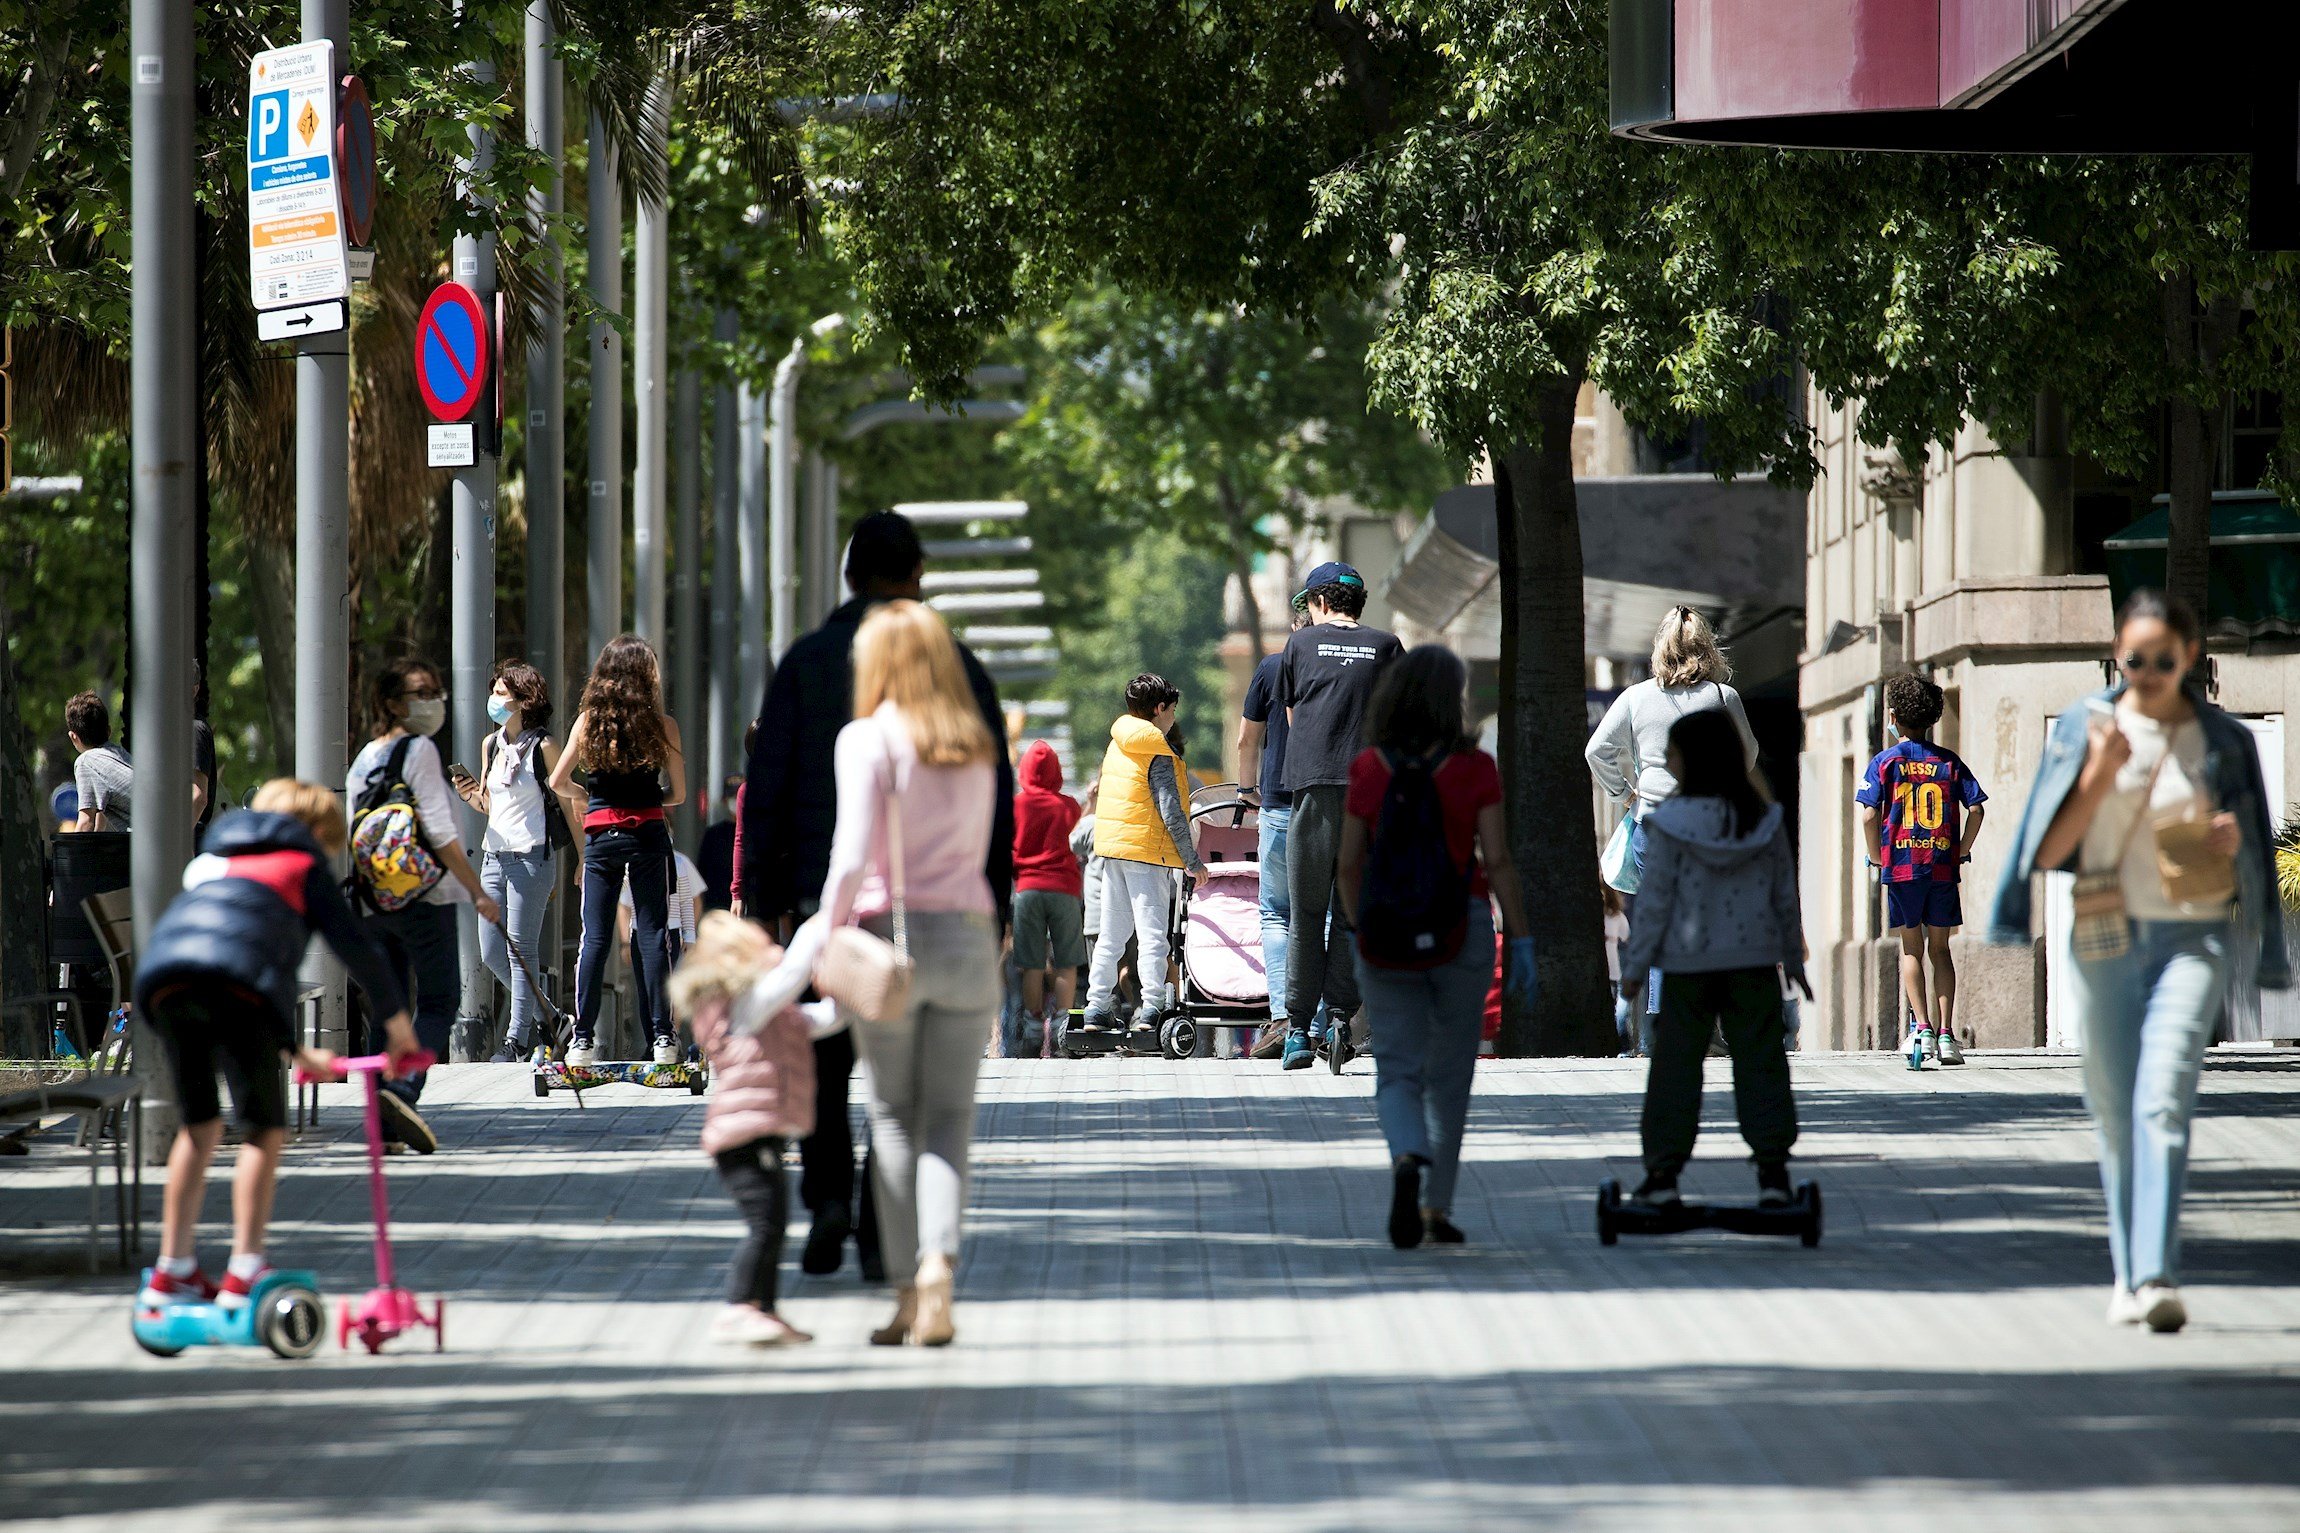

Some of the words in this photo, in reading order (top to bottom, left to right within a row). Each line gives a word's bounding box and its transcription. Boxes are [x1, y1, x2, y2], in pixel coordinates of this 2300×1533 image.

[258, 97, 281, 156] P
[443, 431, 457, 439] Motos
[431, 441, 449, 450] excepte
[1341, 645, 1358, 653] YOUR
[1358, 646, 1376, 654] IDEAS
[1899, 763, 1938, 777] MESSI
[1894, 782, 1943, 829] 10
[1895, 835, 1936, 849] unicef
